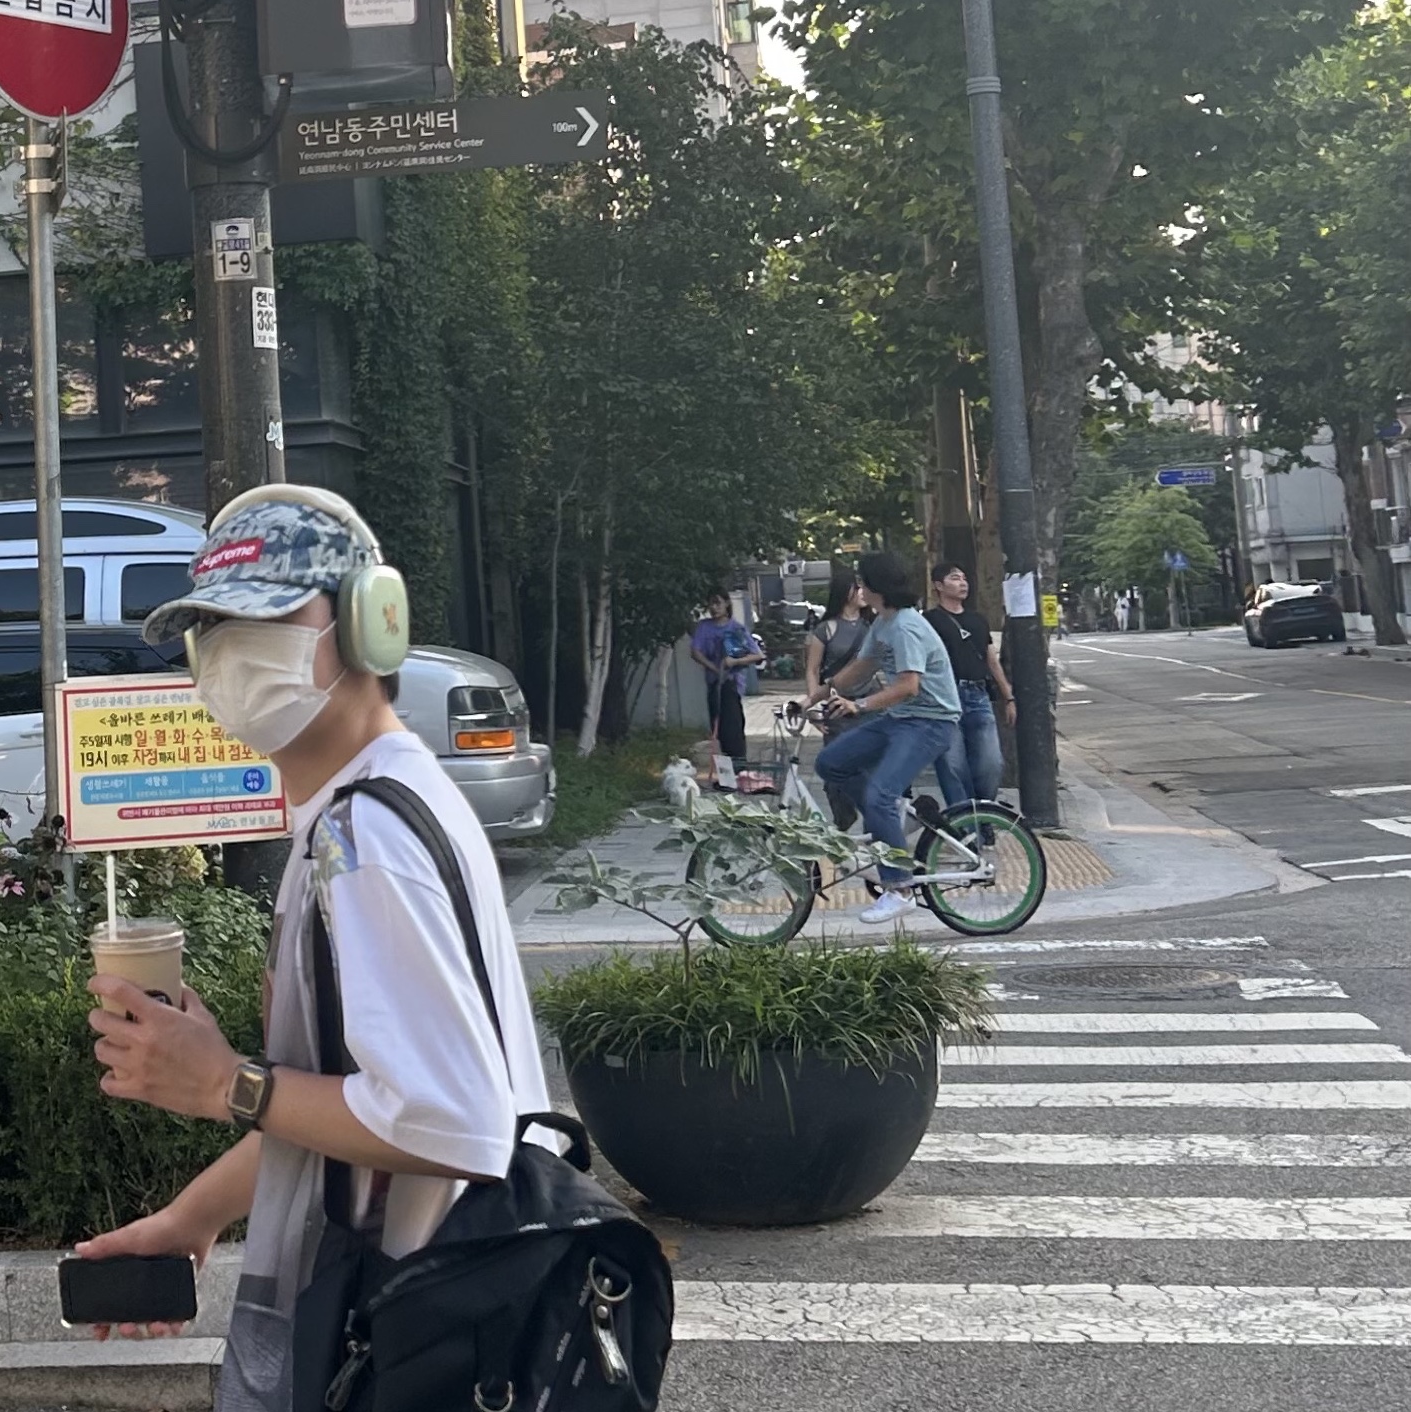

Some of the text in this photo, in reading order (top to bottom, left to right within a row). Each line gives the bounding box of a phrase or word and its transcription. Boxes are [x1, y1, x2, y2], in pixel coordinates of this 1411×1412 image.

[297, 108, 458, 146] 연남동주민센터
[552, 122, 577, 133] 100m
[299, 138, 485, 160] Yeonnam-dong Community Service Center
[218, 251, 252, 275] 1-9
[197, 545, 256, 569] Supreme
[150, 709, 188, 724] 쓰레기
[79, 734, 112, 748] 주5일제
[80, 750, 108, 768] 19시
[111, 753, 129, 765] 이후
[85, 777, 127, 791] 생활쓰레기
[145, 775, 169, 787] 재활용
